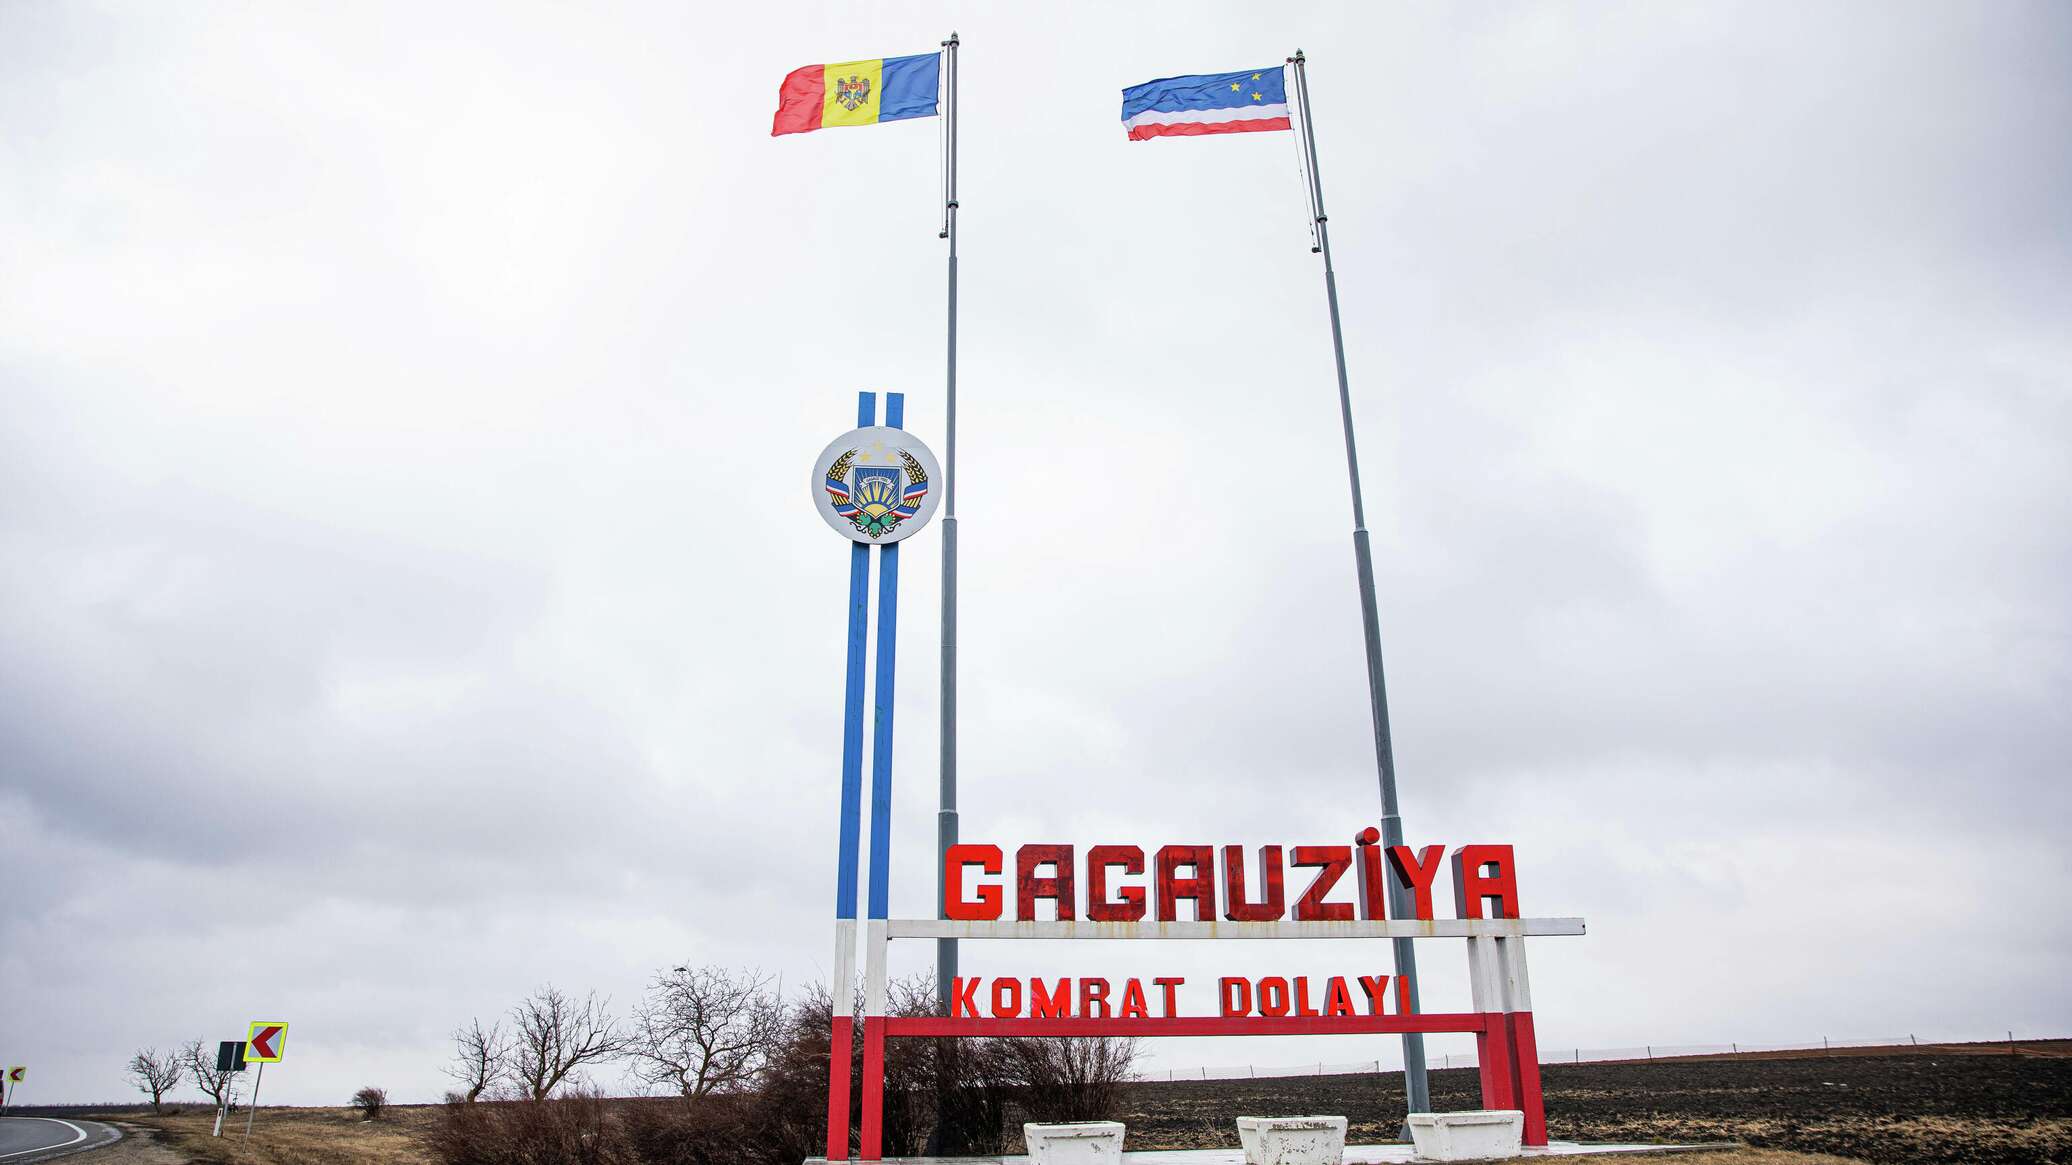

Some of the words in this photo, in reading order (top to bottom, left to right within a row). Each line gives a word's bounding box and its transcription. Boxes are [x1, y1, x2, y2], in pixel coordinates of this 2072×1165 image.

[945, 827, 1520, 921] GAGAUZİYA
[951, 977, 1184, 1018] KOMRAT
[1219, 975, 1412, 1018] DOLAYI
